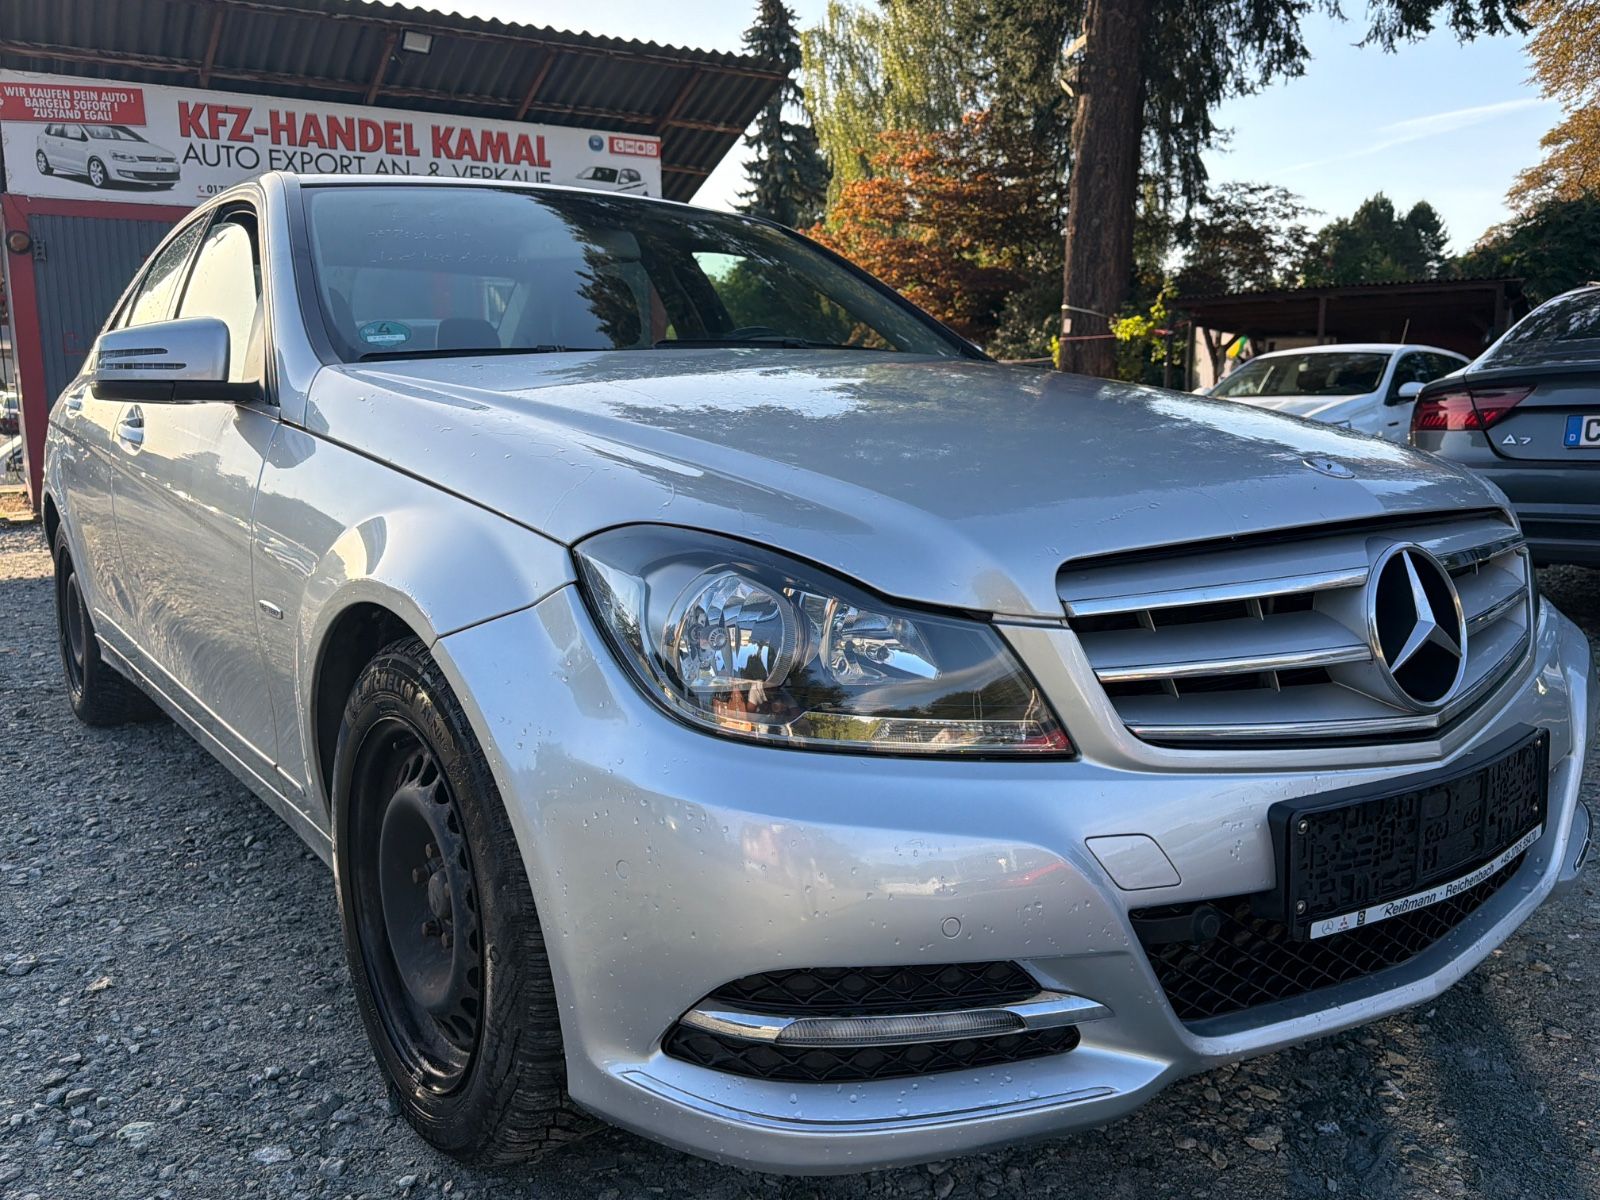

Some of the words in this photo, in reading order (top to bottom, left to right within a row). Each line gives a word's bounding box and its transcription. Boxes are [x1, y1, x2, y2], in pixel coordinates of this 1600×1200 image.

[4, 86, 26, 97] WIR
[29, 87, 70, 99] KAUFEN
[73, 90, 98, 100] DEIN
[101, 93, 128, 103] AUTO
[24, 97, 71, 109] BARGELD
[74, 101, 111, 111] SOFORT
[33, 107, 81, 119] ZUSTAND
[84, 111, 112, 121] EGAL!
[178, 101, 420, 157] KFZ-HANDEL
[431, 124, 551, 168] KAMAL
[182, 142, 260, 170] AUTO
[269, 149, 366, 174] EXPORT
[428, 162, 444, 176] &
[1502, 433, 1531, 445] A7
[1569, 433, 1576, 442] D
[1585, 418, 1600, 442] C
[1381, 891, 1436, 917] Reißmann
[1445, 863, 1495, 897] Reichenbach
